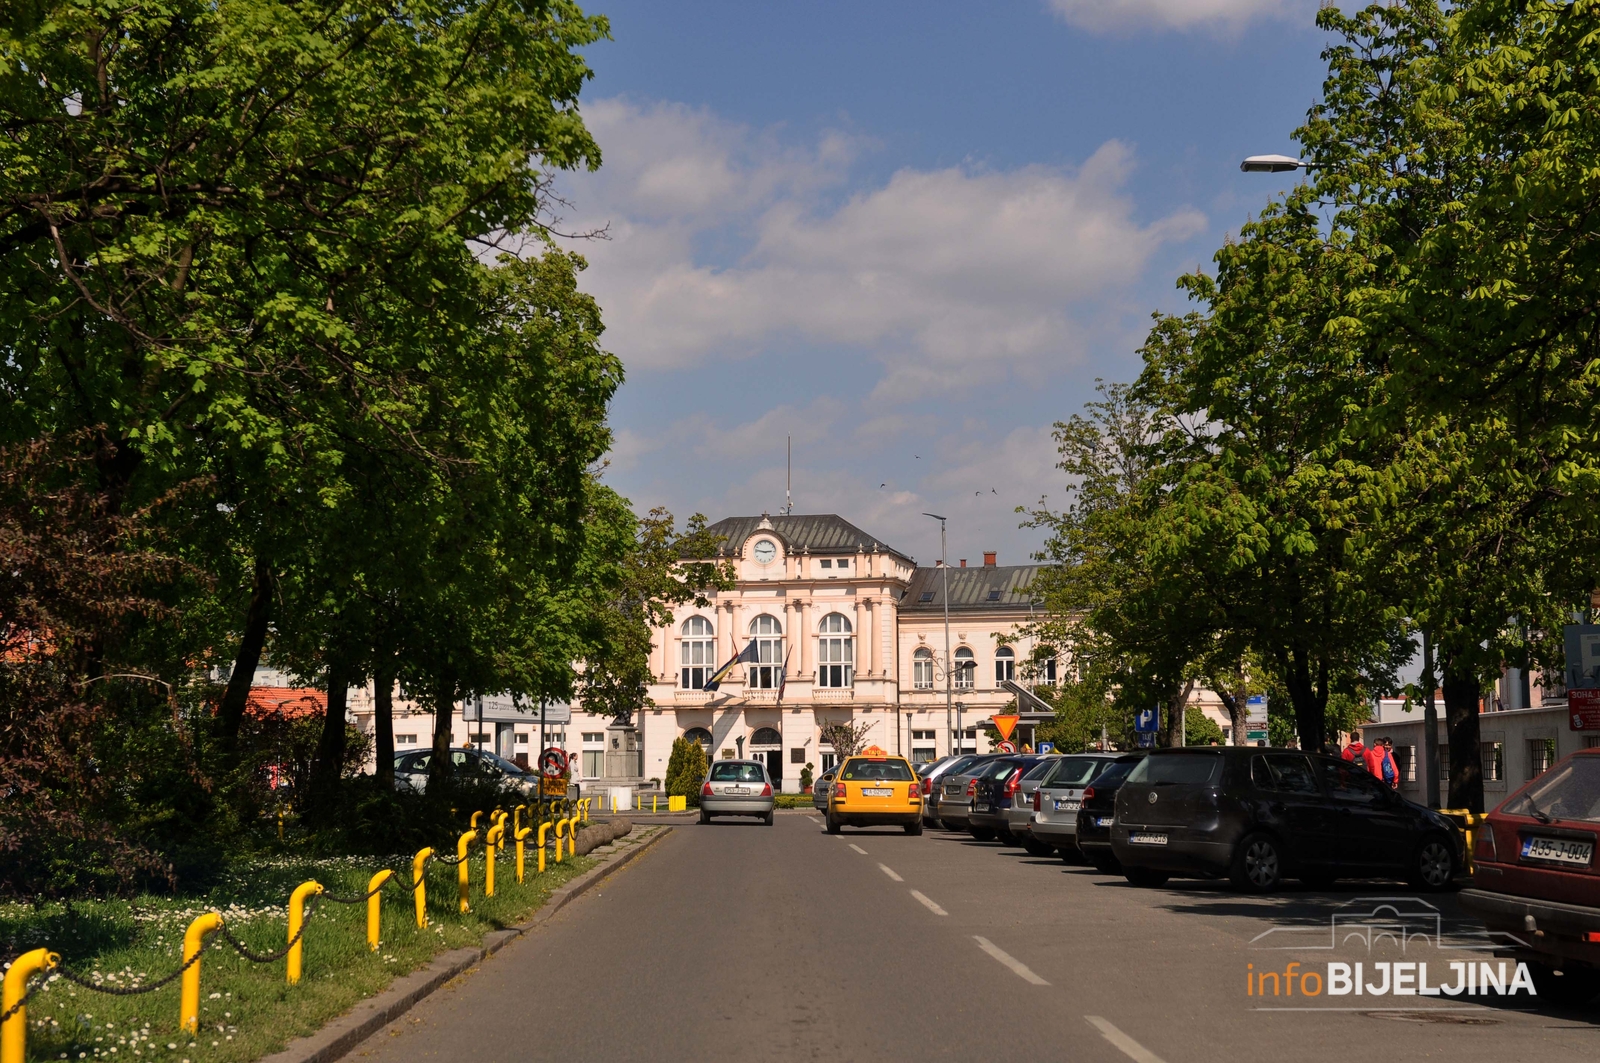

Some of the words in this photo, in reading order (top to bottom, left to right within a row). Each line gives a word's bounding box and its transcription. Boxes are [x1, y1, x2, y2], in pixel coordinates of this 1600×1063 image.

[1571, 691, 1593, 699] ЗОНА
[487, 701, 498, 710] 125
[1140, 709, 1153, 728] P
[1042, 745, 1050, 755] P
[1530, 840, 1590, 861] A35-J-004
